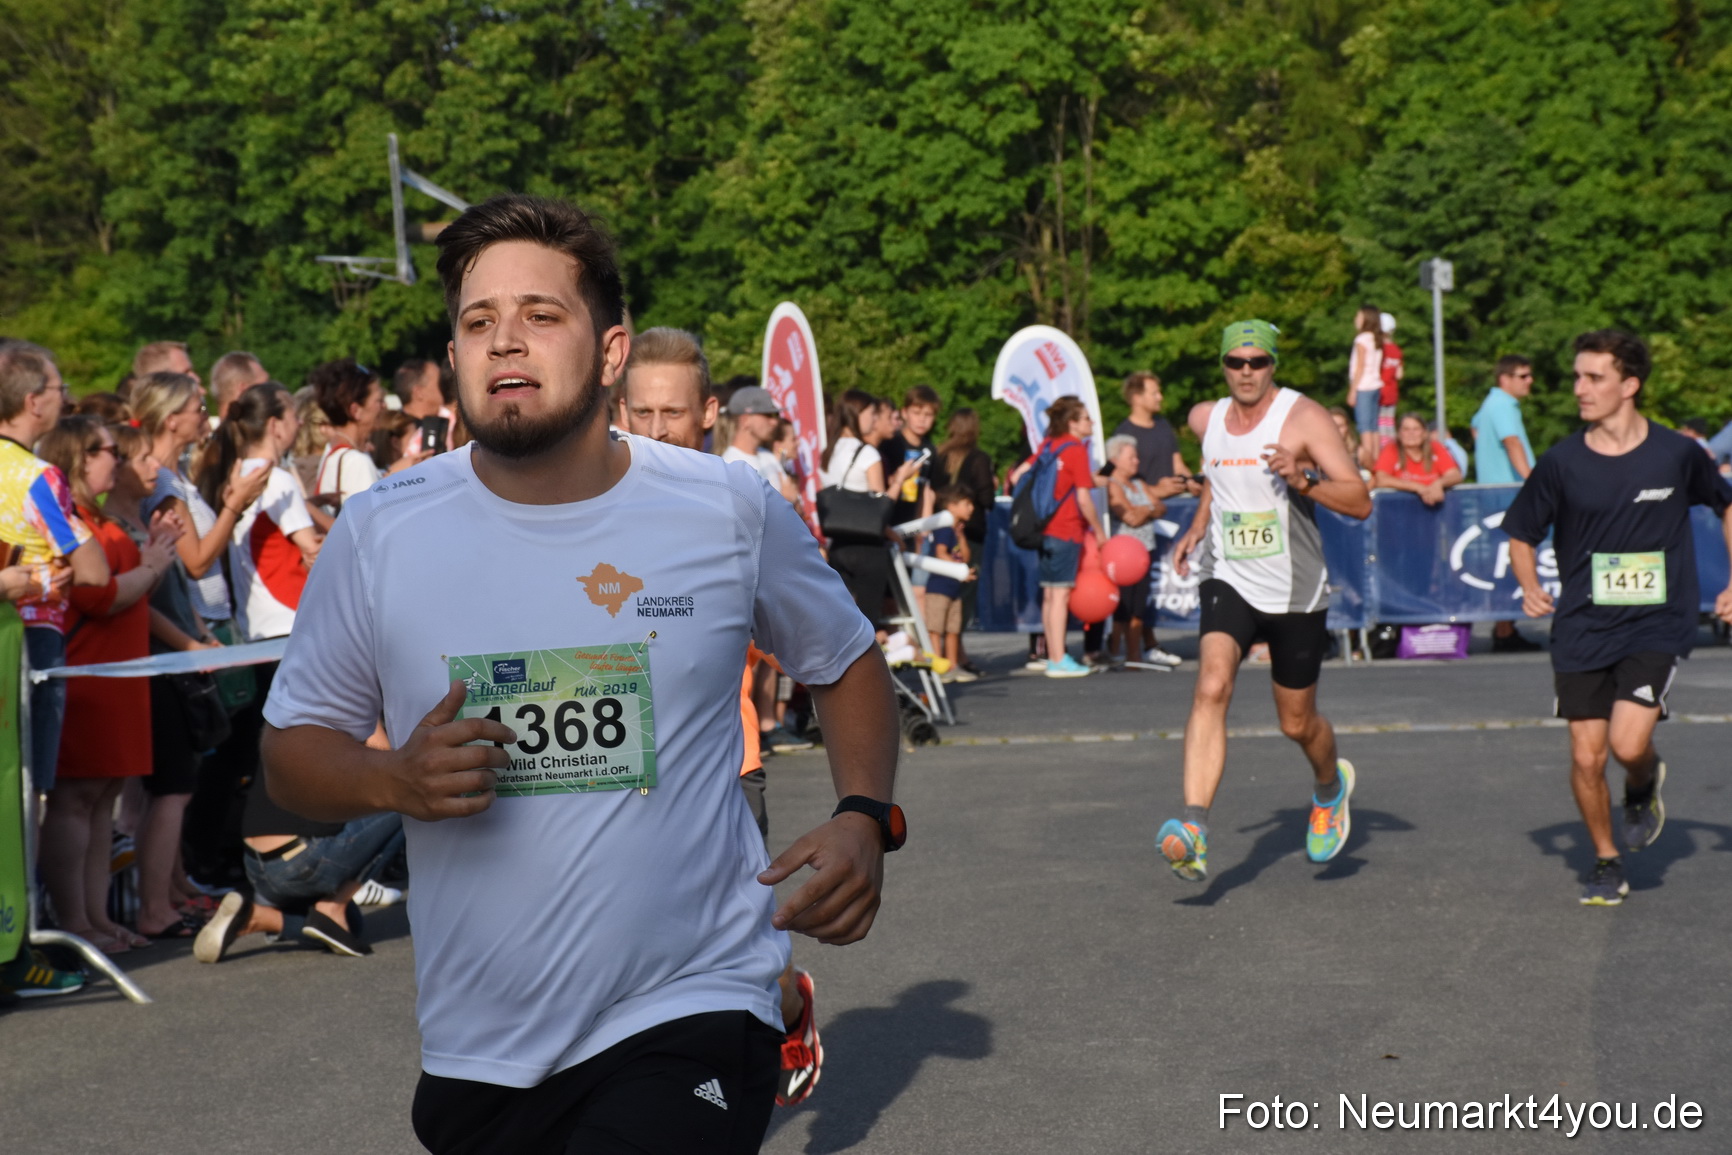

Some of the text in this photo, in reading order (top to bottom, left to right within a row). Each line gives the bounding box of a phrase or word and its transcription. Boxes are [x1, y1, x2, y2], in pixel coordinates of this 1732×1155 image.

[392, 476, 427, 489] JAKO
[1229, 527, 1274, 545] 1176
[1603, 571, 1655, 589] 1412
[598, 582, 621, 595] NM
[637, 596, 694, 606] LANDKREIS
[637, 607, 694, 617] NEUMARKT
[480, 677, 557, 695] firmenlauf
[602, 682, 637, 695] 2019
[505, 754, 607, 772] Wild Christian
[496, 765, 632, 784] ndratsamt Neumarkt i.d.OPf.
